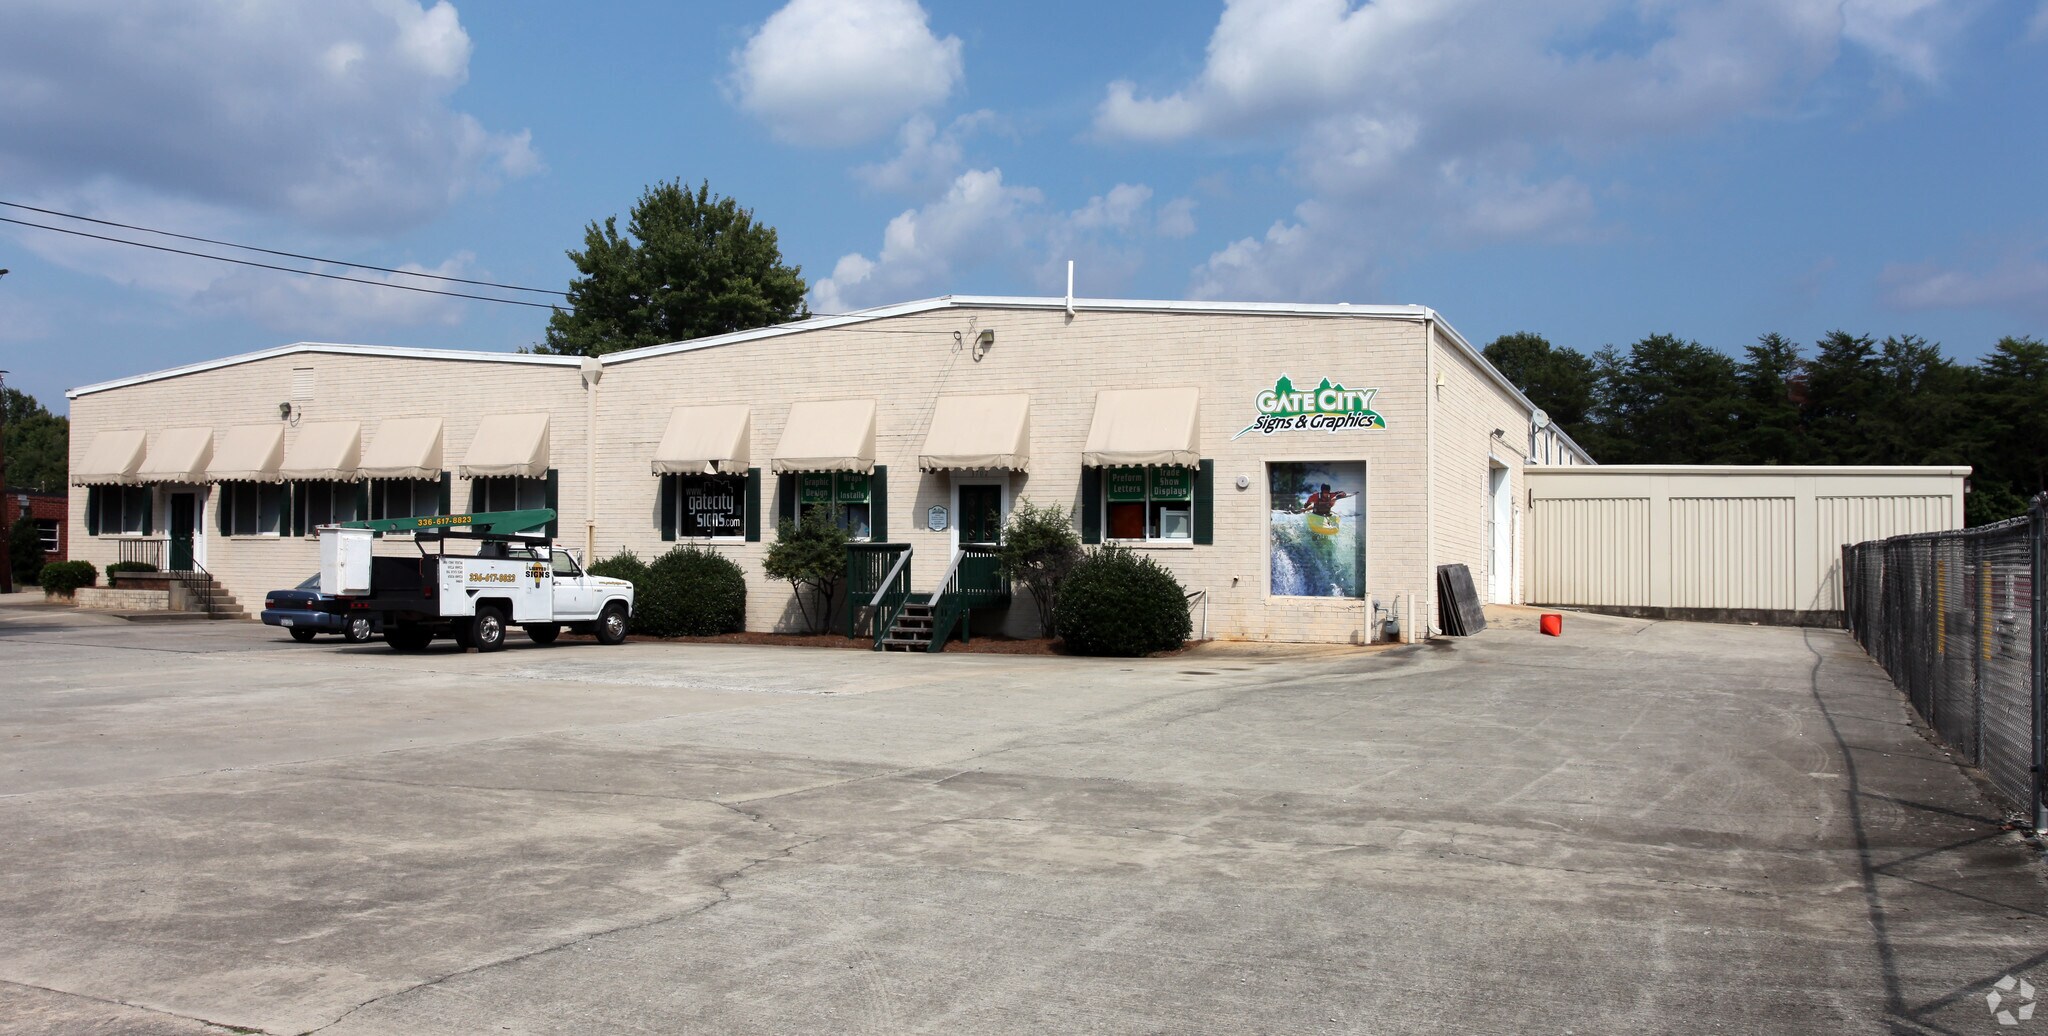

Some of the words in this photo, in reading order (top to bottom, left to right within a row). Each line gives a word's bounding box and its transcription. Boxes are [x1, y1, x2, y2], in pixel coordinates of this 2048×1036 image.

[1257, 391, 1315, 412] GATE
[1318, 390, 1373, 411] CITY
[1253, 415, 1294, 434] Signs
[1295, 415, 1308, 429] &
[1309, 412, 1376, 432] Graphics
[1159, 468, 1180, 477] Trade
[804, 478, 830, 487] Graphic
[1160, 477, 1179, 486] Show
[805, 488, 828, 499] Design
[1113, 485, 1141, 493] Letters
[1154, 486, 1187, 497] Displays
[840, 491, 865, 499] Installs
[688, 492, 734, 515] gatecity
[417, 516, 472, 527] 336-617-8823
[469, 573, 516, 582] 336-617-8823
[525, 570, 550, 578] SIGNS
